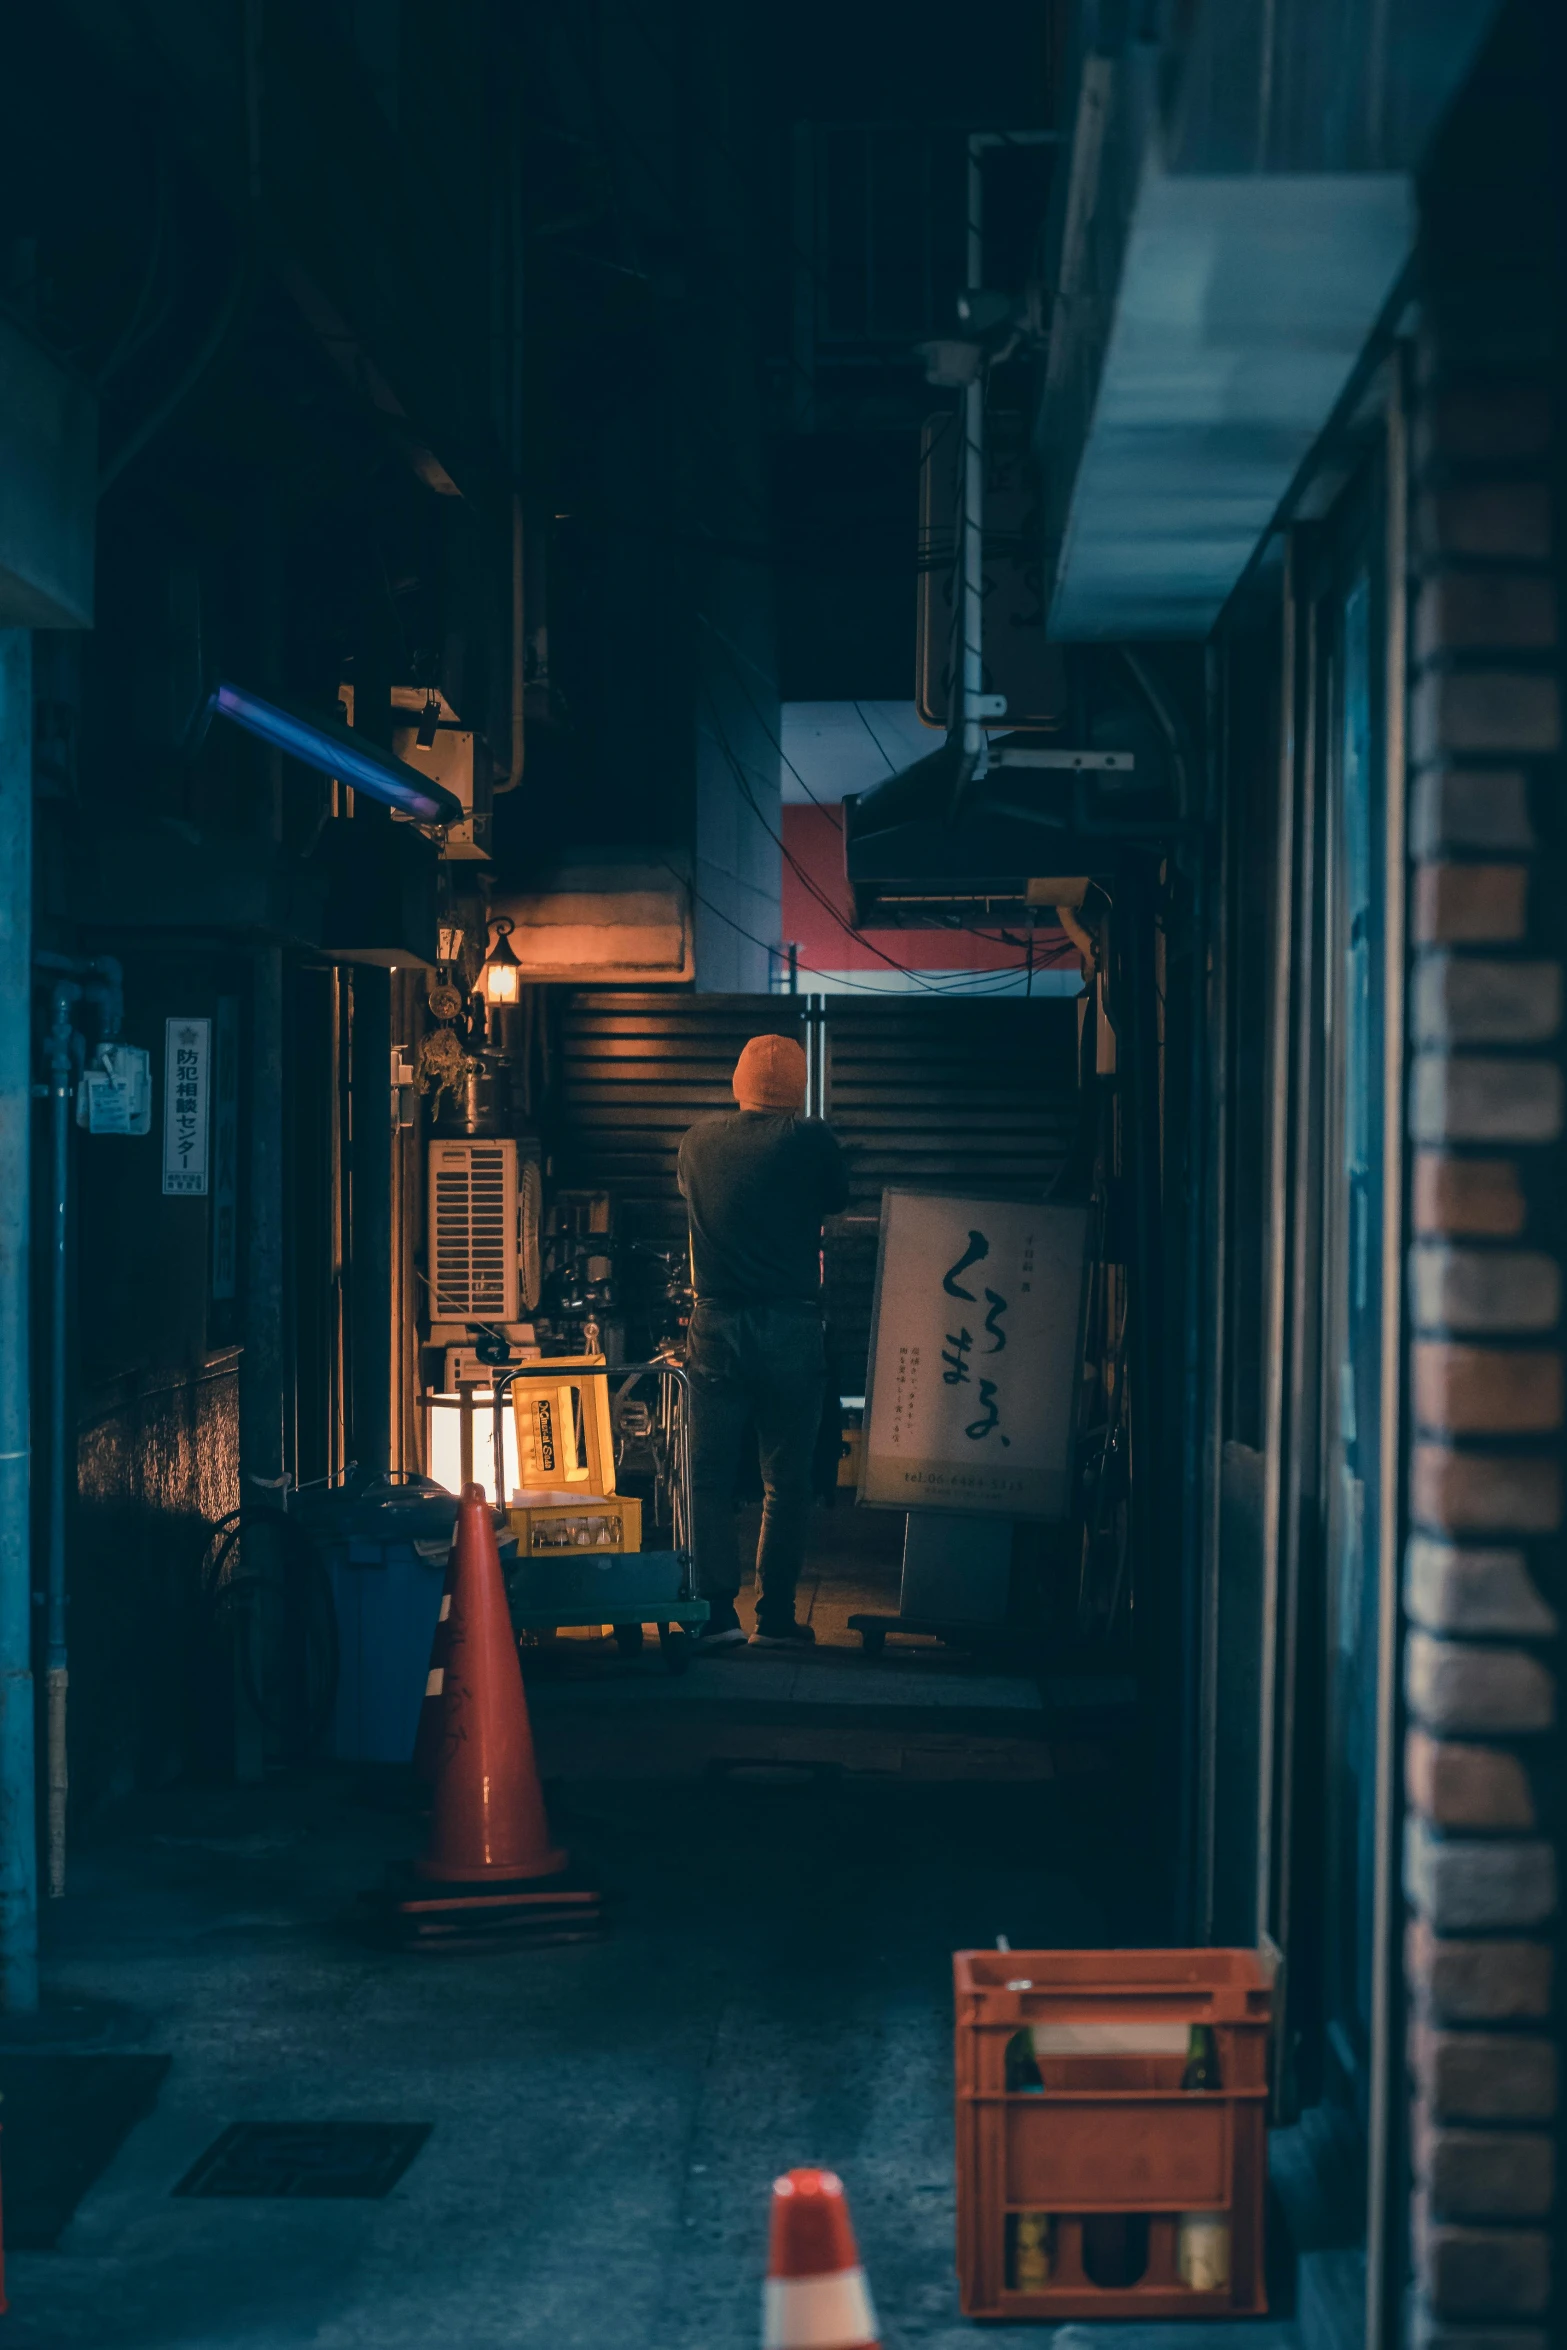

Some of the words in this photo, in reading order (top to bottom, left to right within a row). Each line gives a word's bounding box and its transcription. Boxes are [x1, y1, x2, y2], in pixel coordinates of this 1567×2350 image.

[176, 1049, 199, 1169] 防犯相談センター
[539, 1402, 551, 1443] Mineral
[543, 1445, 553, 1469] Soda
